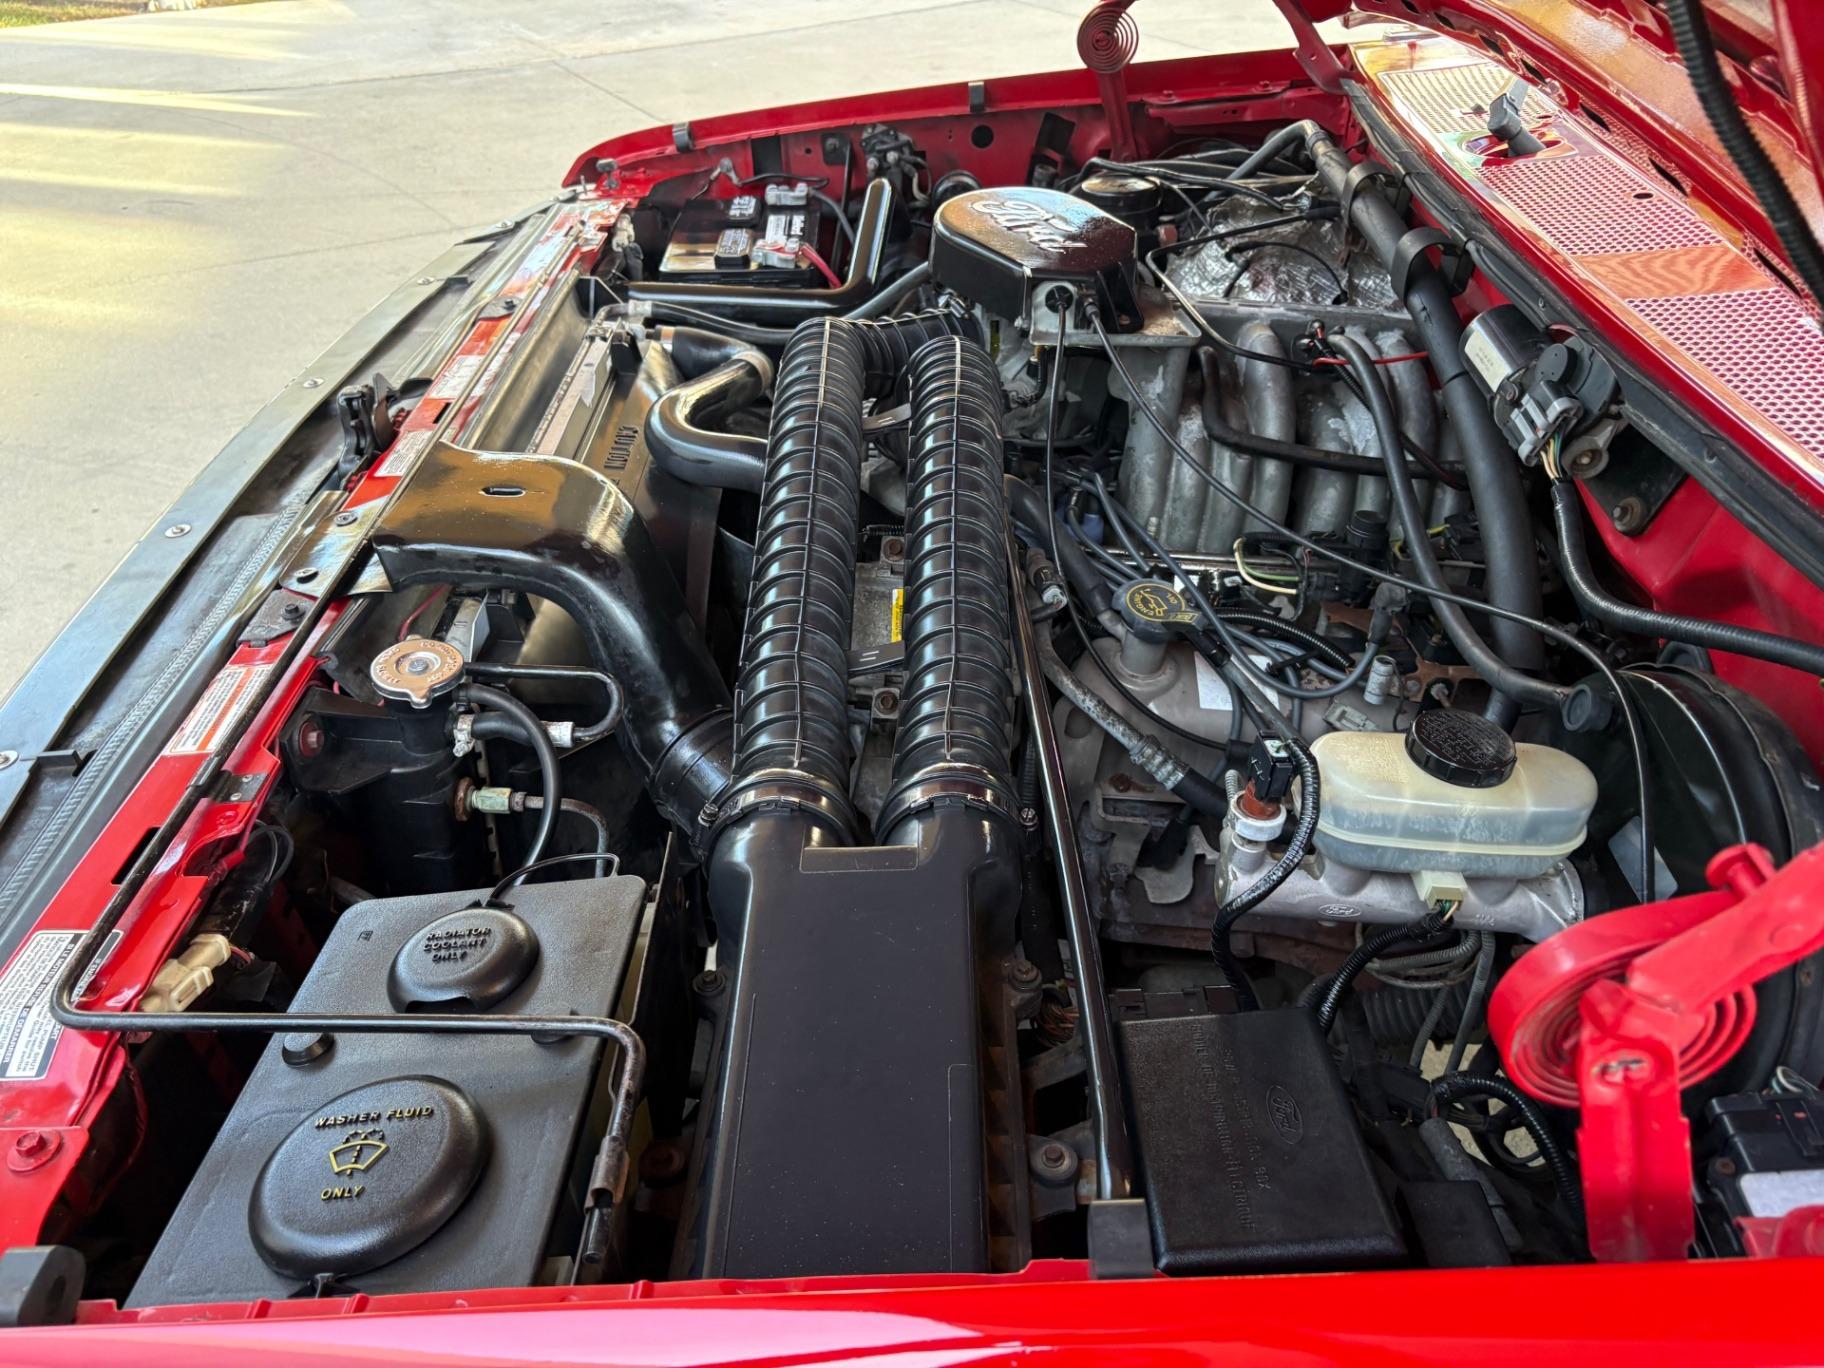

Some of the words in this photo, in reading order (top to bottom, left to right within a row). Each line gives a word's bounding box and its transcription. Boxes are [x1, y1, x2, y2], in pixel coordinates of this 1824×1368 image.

[970, 200, 1089, 254] Ford
[426, 927, 492, 942] RADIATOR
[423, 938, 488, 953] COOLANT
[432, 950, 468, 964] ONLY
[315, 1110, 382, 1129] WASHER
[385, 1105, 435, 1121] FLUID
[1270, 1096, 1299, 1134] Ford
[320, 1184, 366, 1202] ONLY
